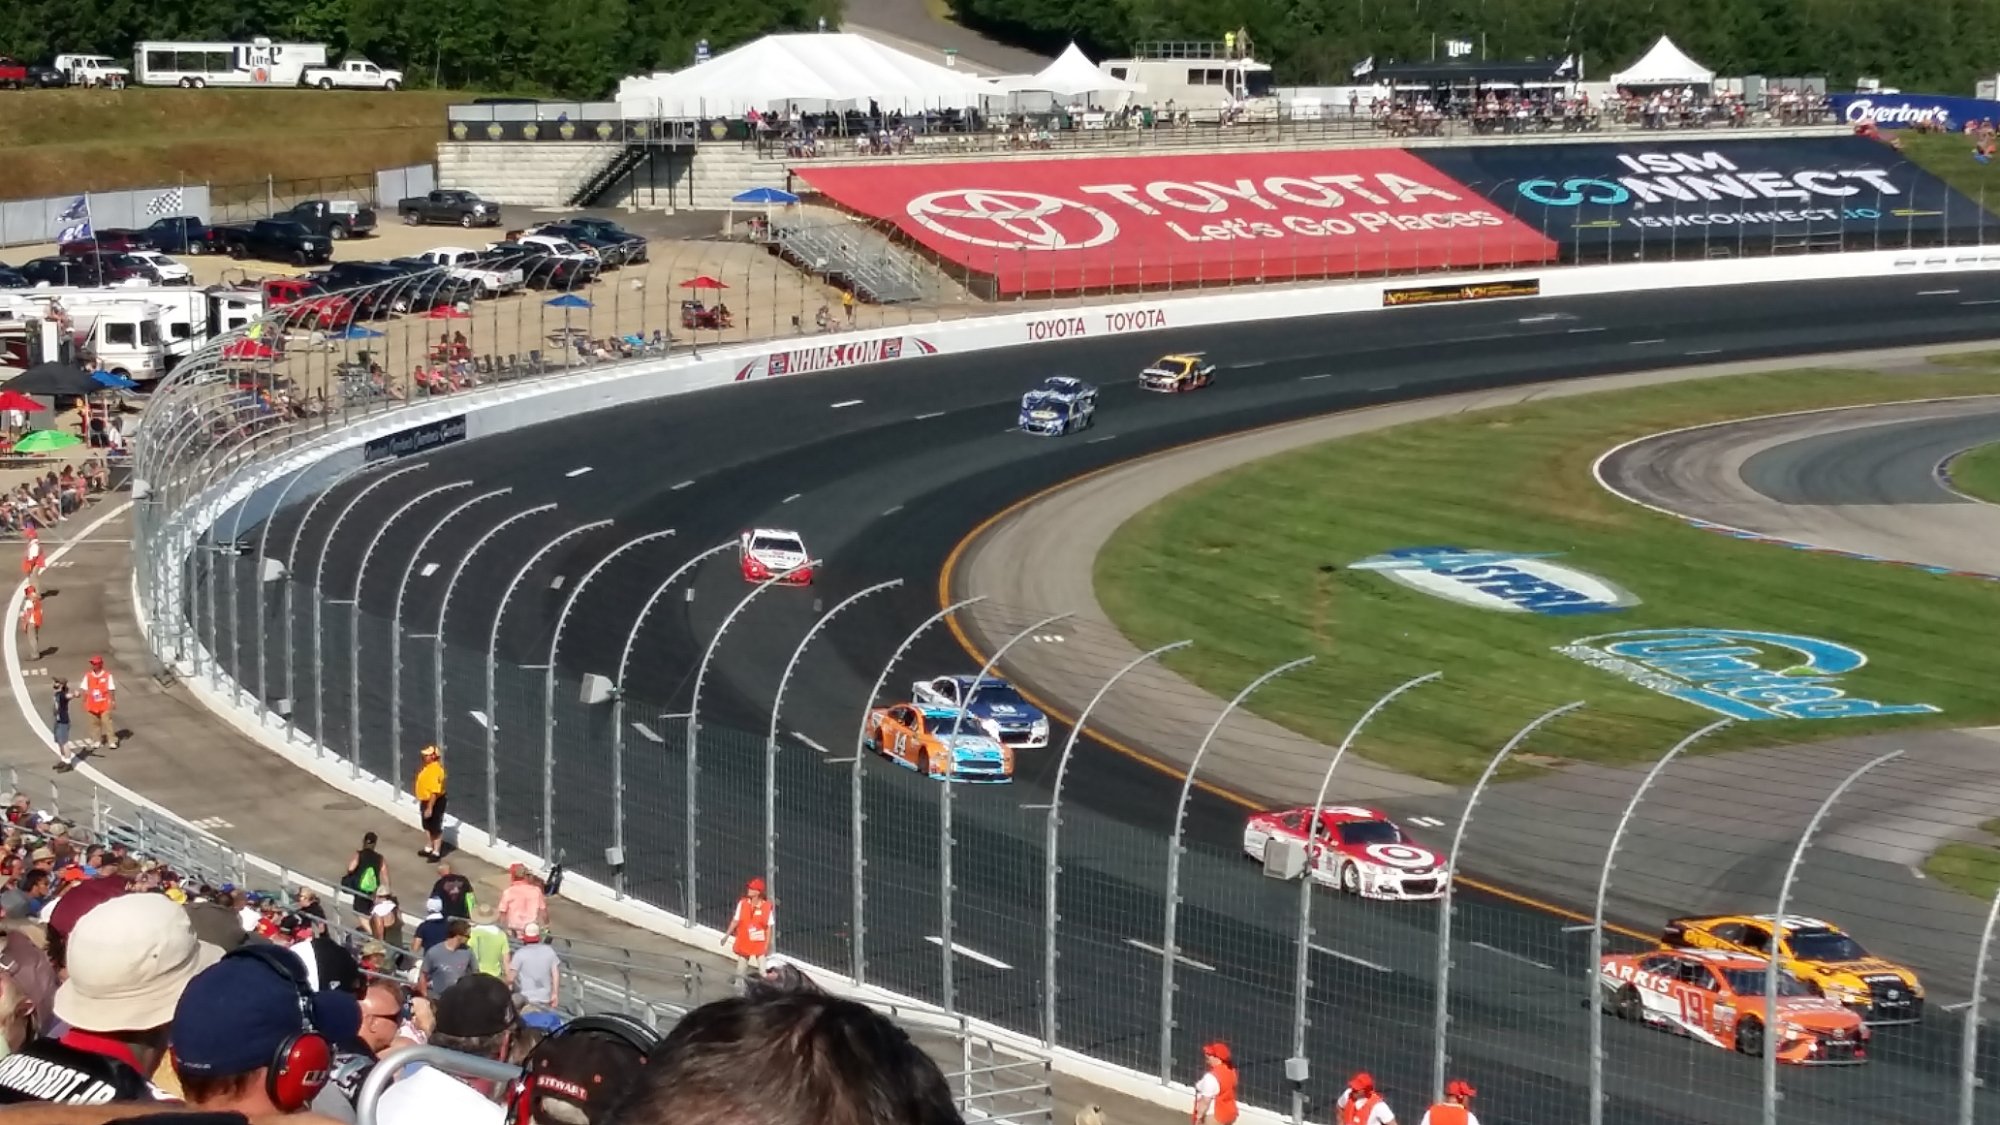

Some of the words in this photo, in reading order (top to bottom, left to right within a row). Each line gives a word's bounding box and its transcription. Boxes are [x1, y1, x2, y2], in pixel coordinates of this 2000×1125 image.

[1444, 40, 1472, 57] Lite
[1846, 99, 1949, 123] Overton's
[1616, 152, 1738, 174] ISM
[1079, 173, 1463, 215] TOYOTA
[1165, 218, 1284, 242] Let's
[1282, 215, 1356, 236] Go
[1350, 211, 1503, 232] Places
[1627, 208, 1881, 227] ISMCONNECT.IO
[1026, 317, 1086, 340] TOYOTA
[1105, 308, 1167, 332] TOYOTA
[788, 339, 883, 373] NHMS.COM
[893, 730, 907, 757] 14
[1602, 961, 1672, 993] ARRIS
[1673, 985, 1705, 1030] 19
[538, 1075, 587, 1101] STEWART
